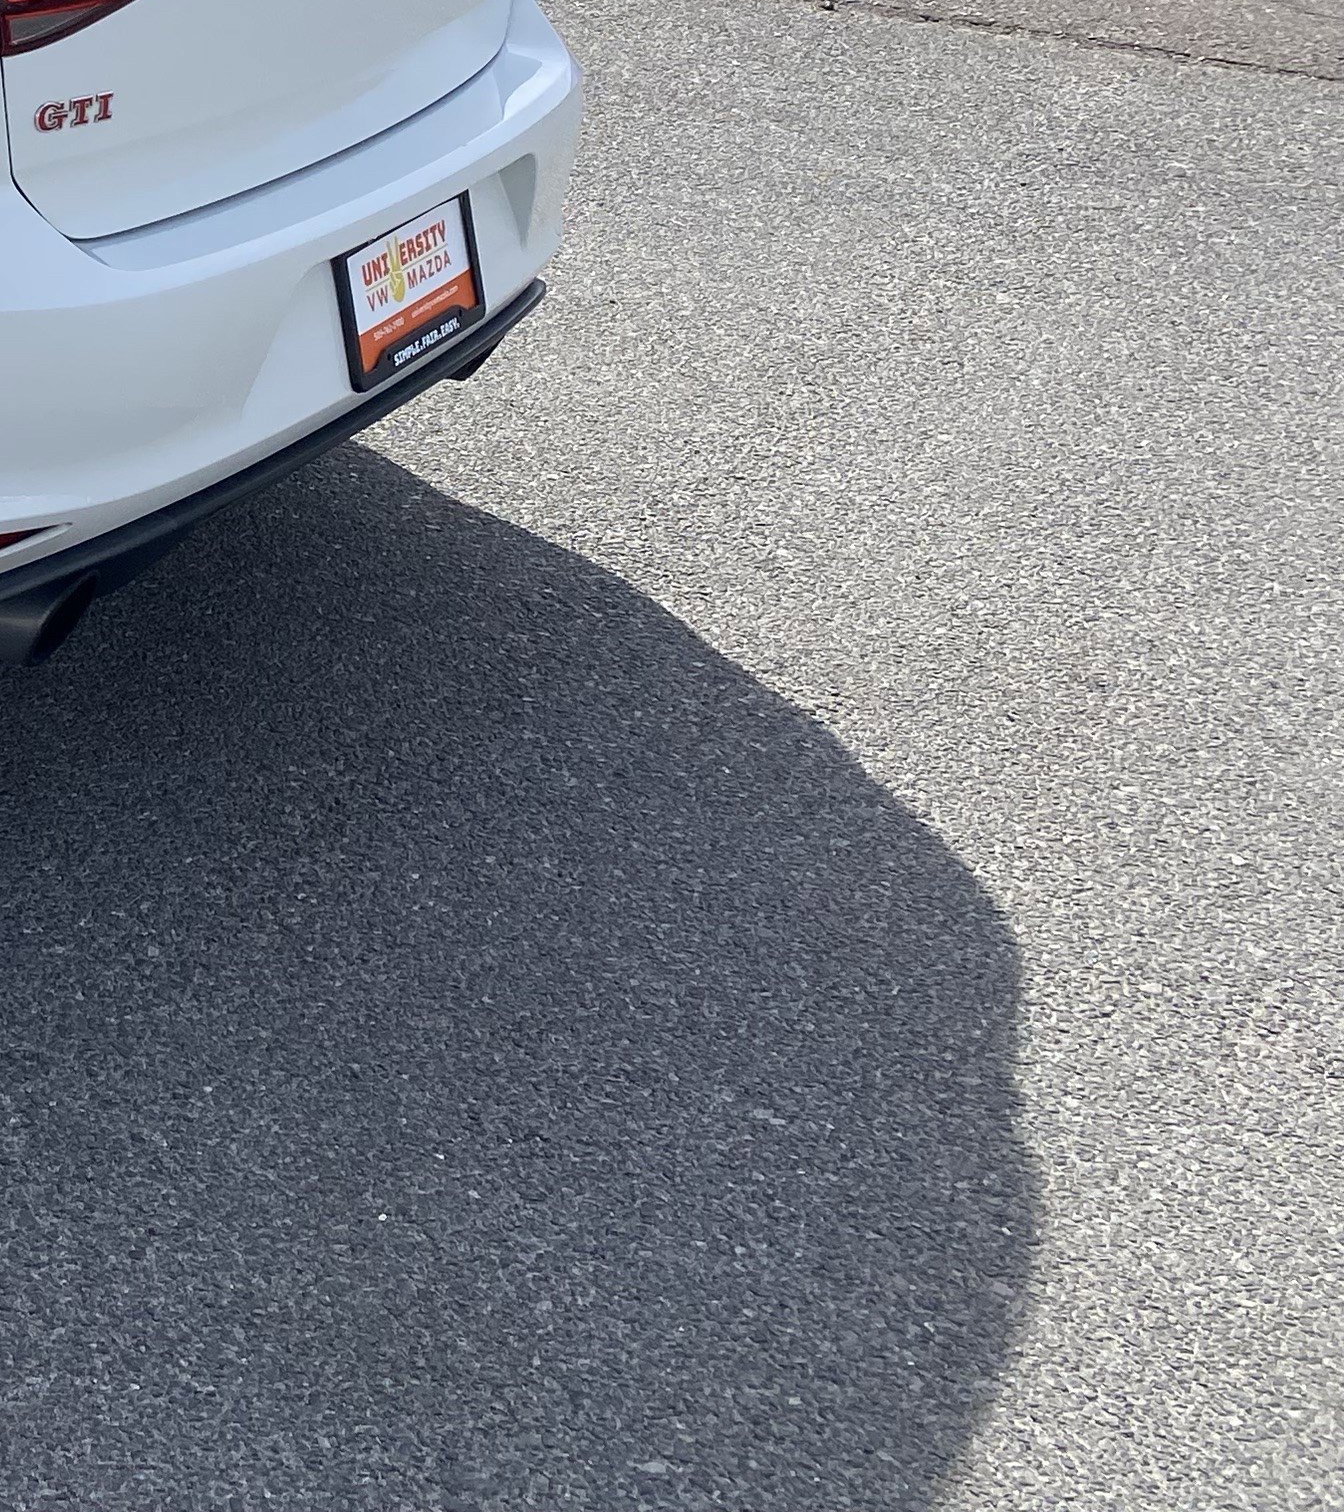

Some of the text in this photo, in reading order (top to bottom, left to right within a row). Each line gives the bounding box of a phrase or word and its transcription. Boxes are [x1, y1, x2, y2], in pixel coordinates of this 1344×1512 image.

[34, 90, 114, 133] GTI
[362, 219, 446, 287] UNIVERSITY
[366, 285, 389, 311] VW
[407, 250, 452, 290] MAZDA
